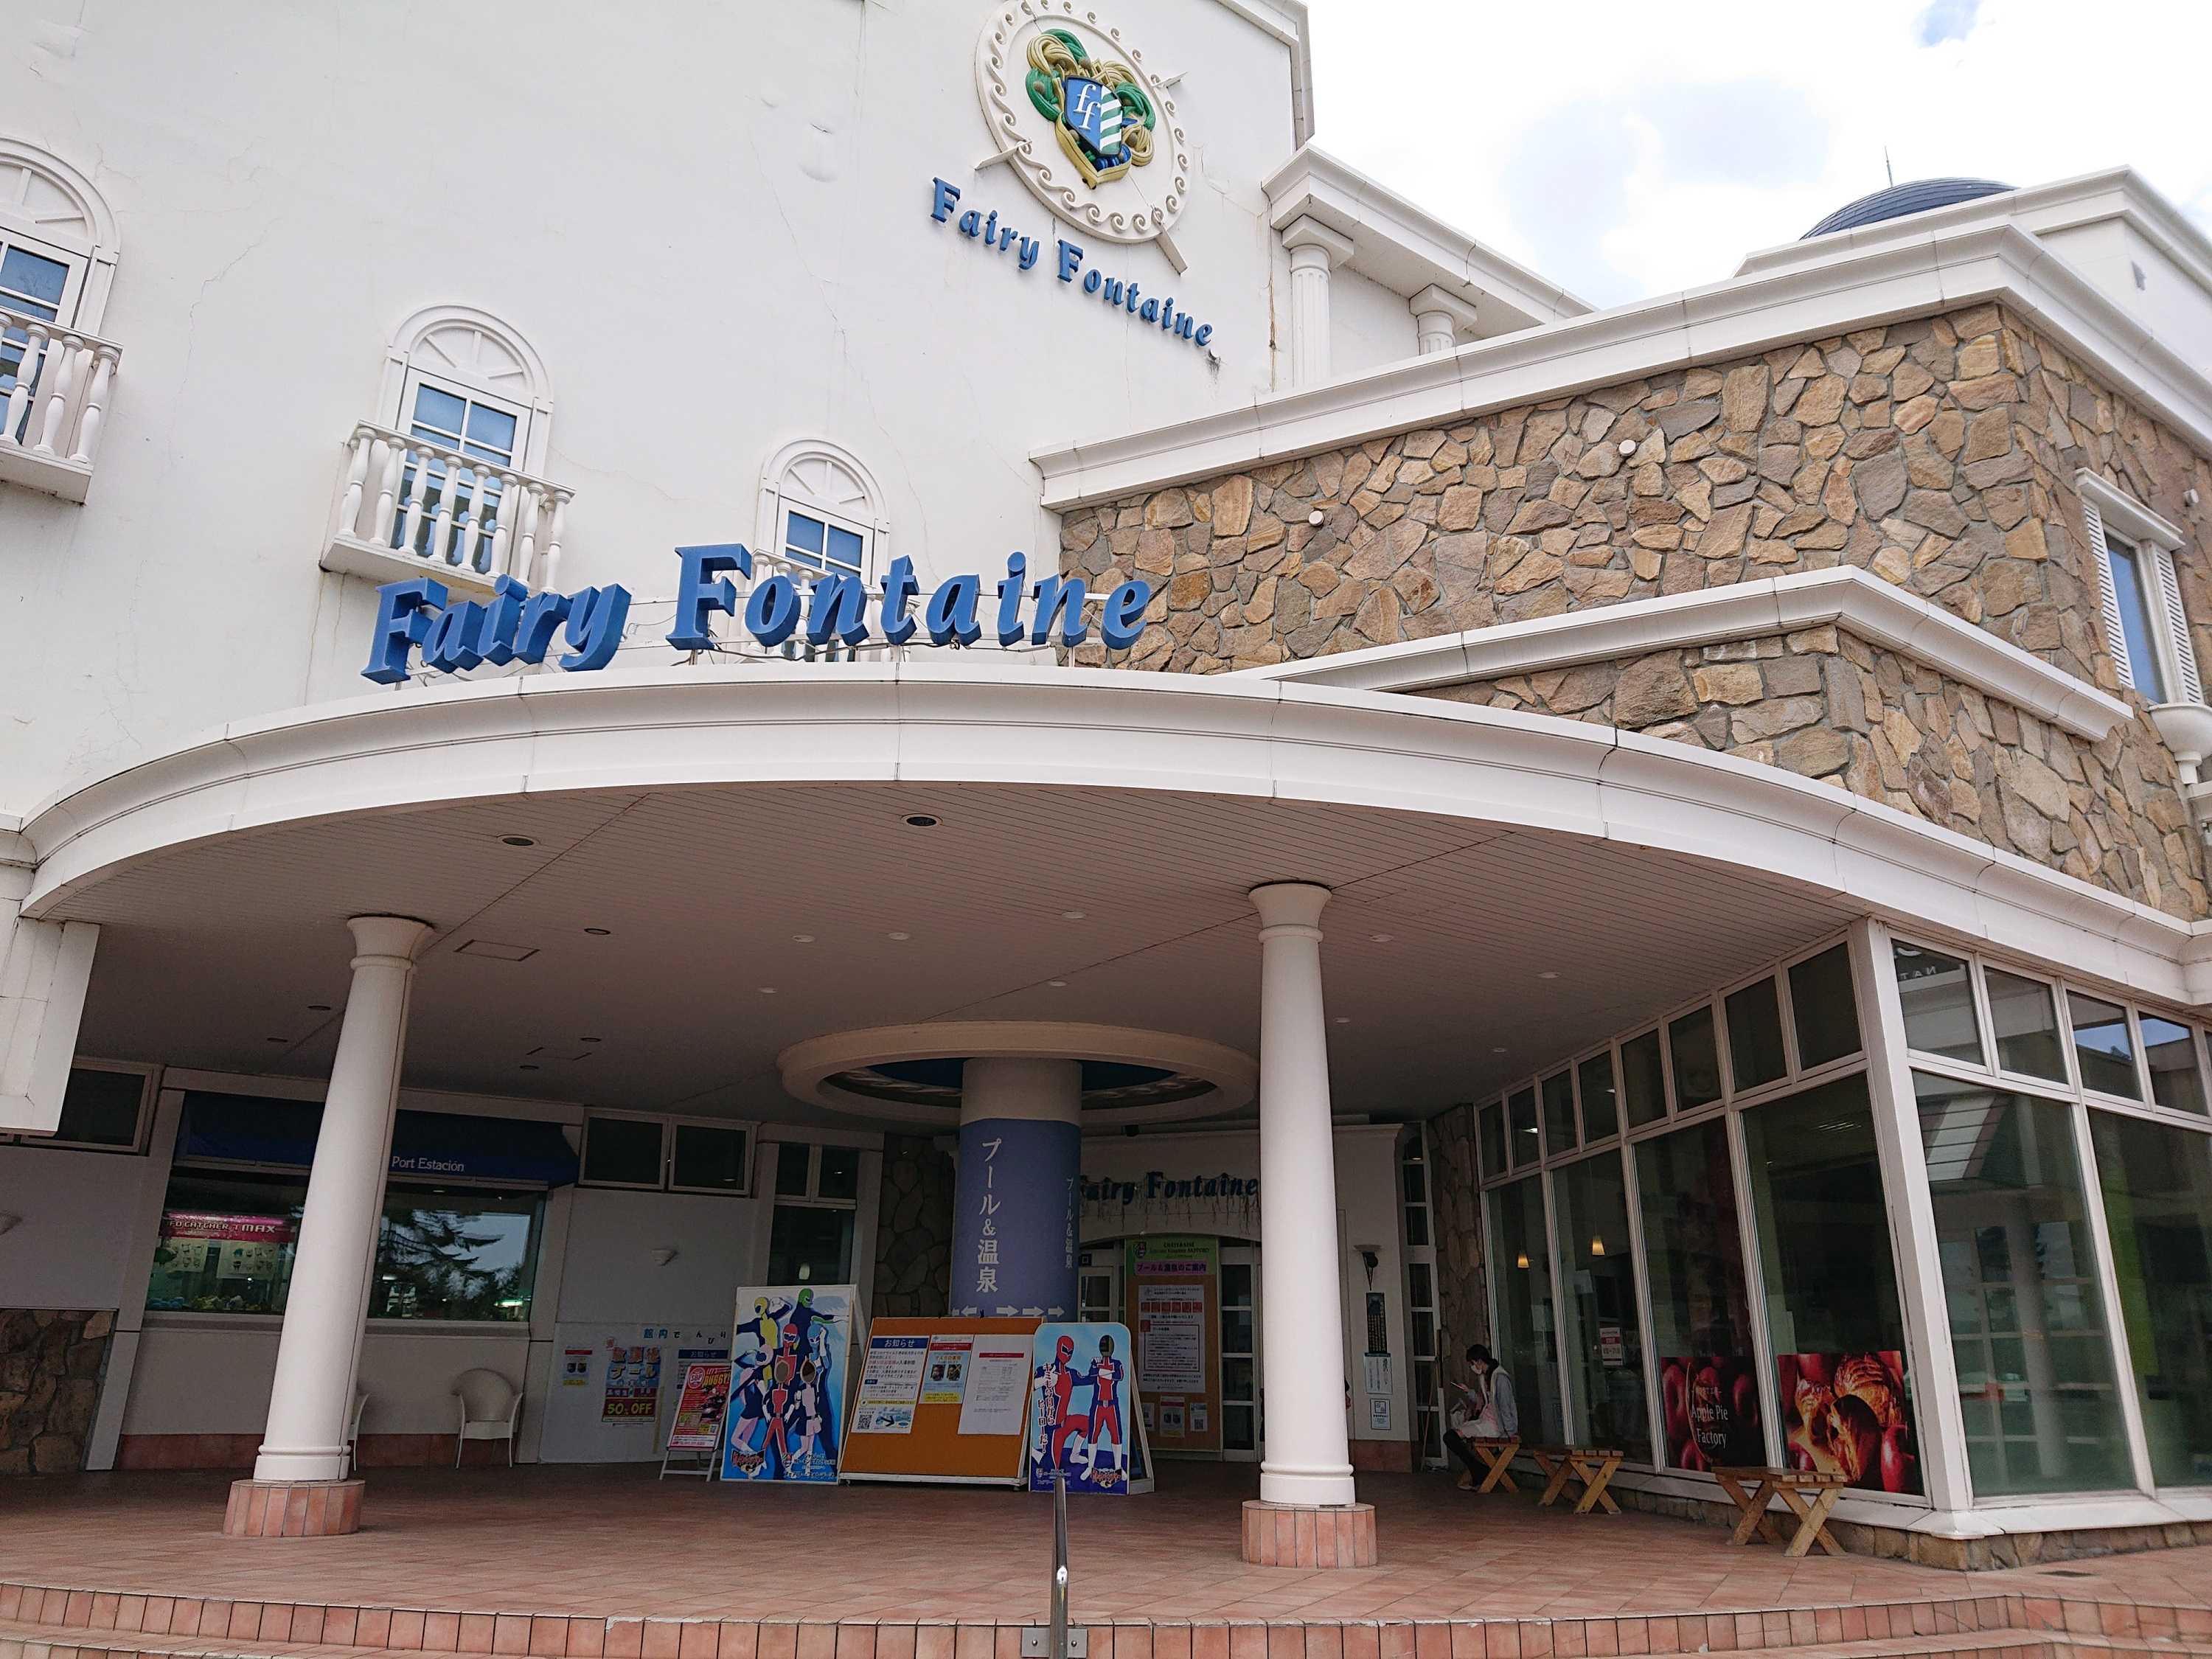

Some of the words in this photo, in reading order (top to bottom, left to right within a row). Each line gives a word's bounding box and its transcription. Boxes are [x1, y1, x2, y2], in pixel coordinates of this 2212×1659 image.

[931, 176, 1040, 271] Fairy
[1057, 239, 1213, 347] Fontaine
[361, 574, 632, 685] Fairy
[665, 543, 1151, 651] Fontaine
[392, 1155, 415, 1169] Port
[417, 1158, 465, 1172] Estación
[1147, 1172, 1258, 1198] Fontaine
[184, 1220, 229, 1230] CATCHER
[242, 1224, 276, 1233] MAX
[975, 1138, 1002, 1293] プール&温泉
[884, 1338, 915, 1347] お知らせ
[1691, 1403, 1715, 1422] Apple
[1715, 1404, 1729, 1421] Pie
[1696, 1427, 1728, 1451] Factory
